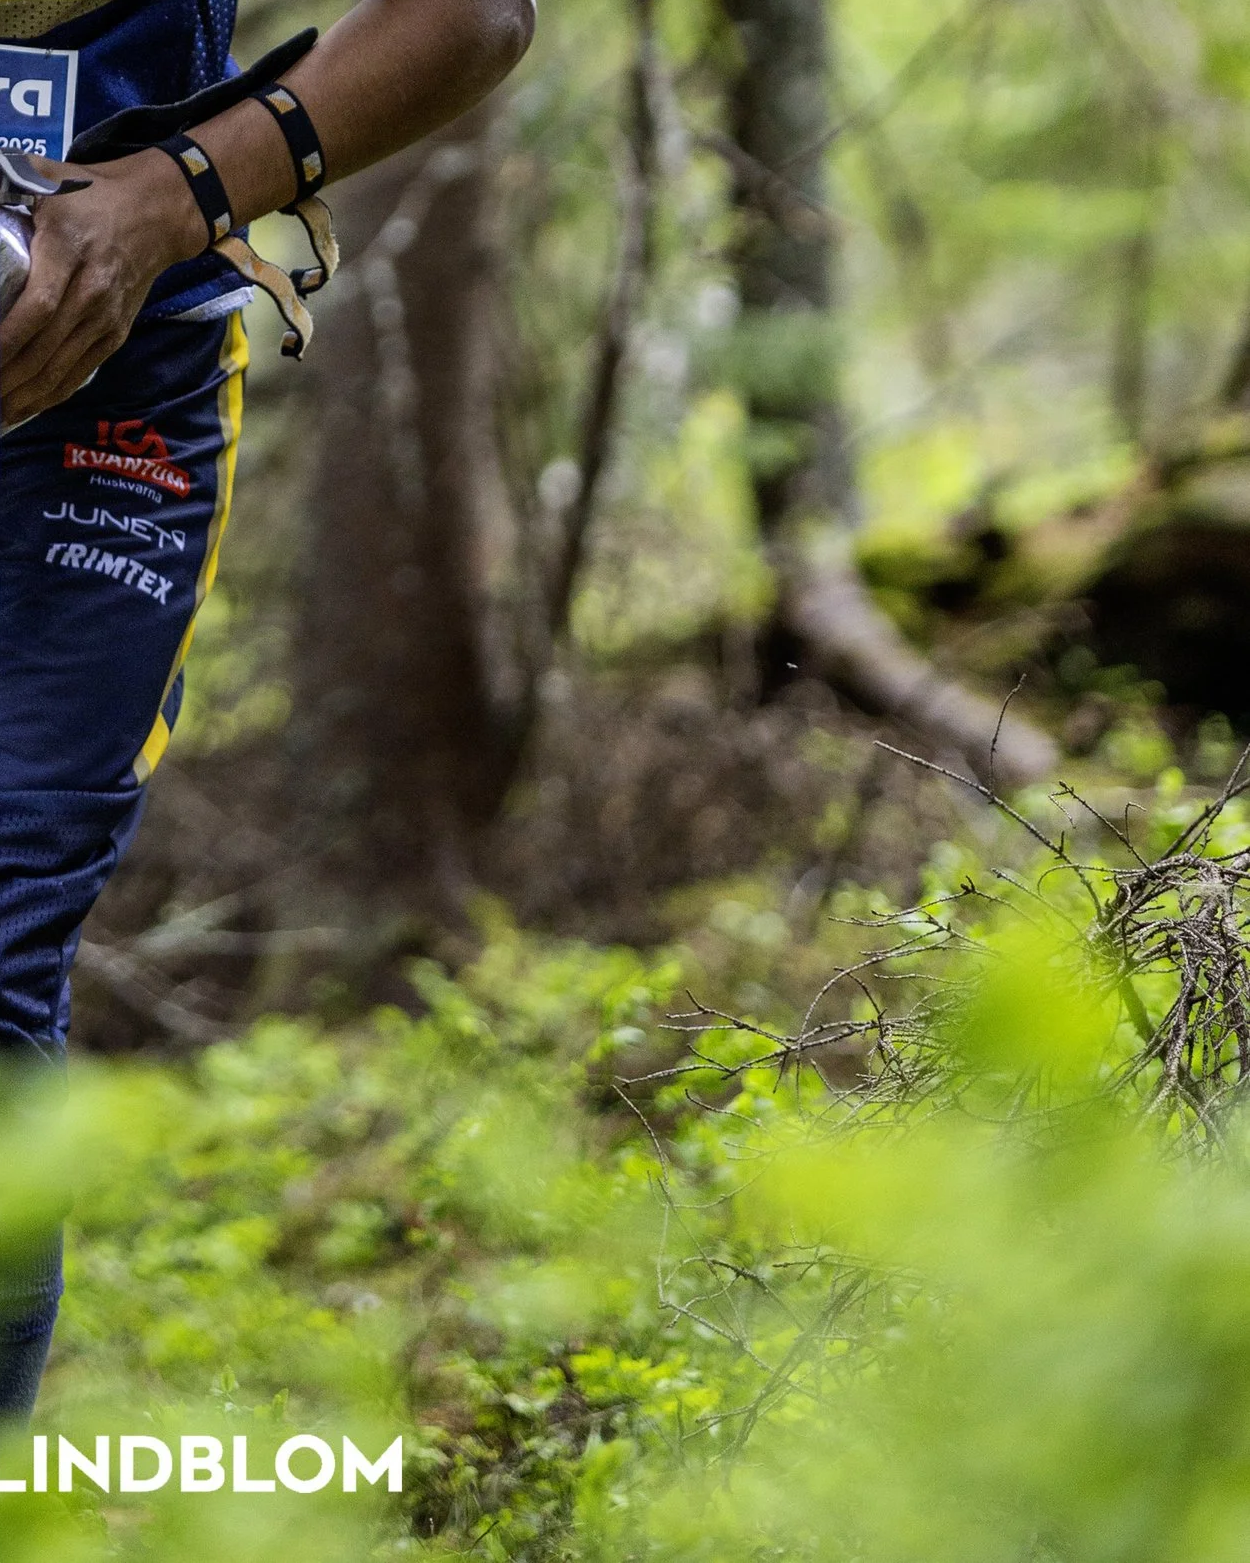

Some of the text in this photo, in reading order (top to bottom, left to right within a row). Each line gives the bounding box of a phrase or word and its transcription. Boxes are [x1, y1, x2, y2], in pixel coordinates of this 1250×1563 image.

[97, 419, 169, 457] ICA
[71, 448, 186, 491] KVANTUM
[89, 474, 163, 504] Huskvarna
[43, 501, 174, 549] JUNET
[45, 542, 174, 605] TRIMTEX
